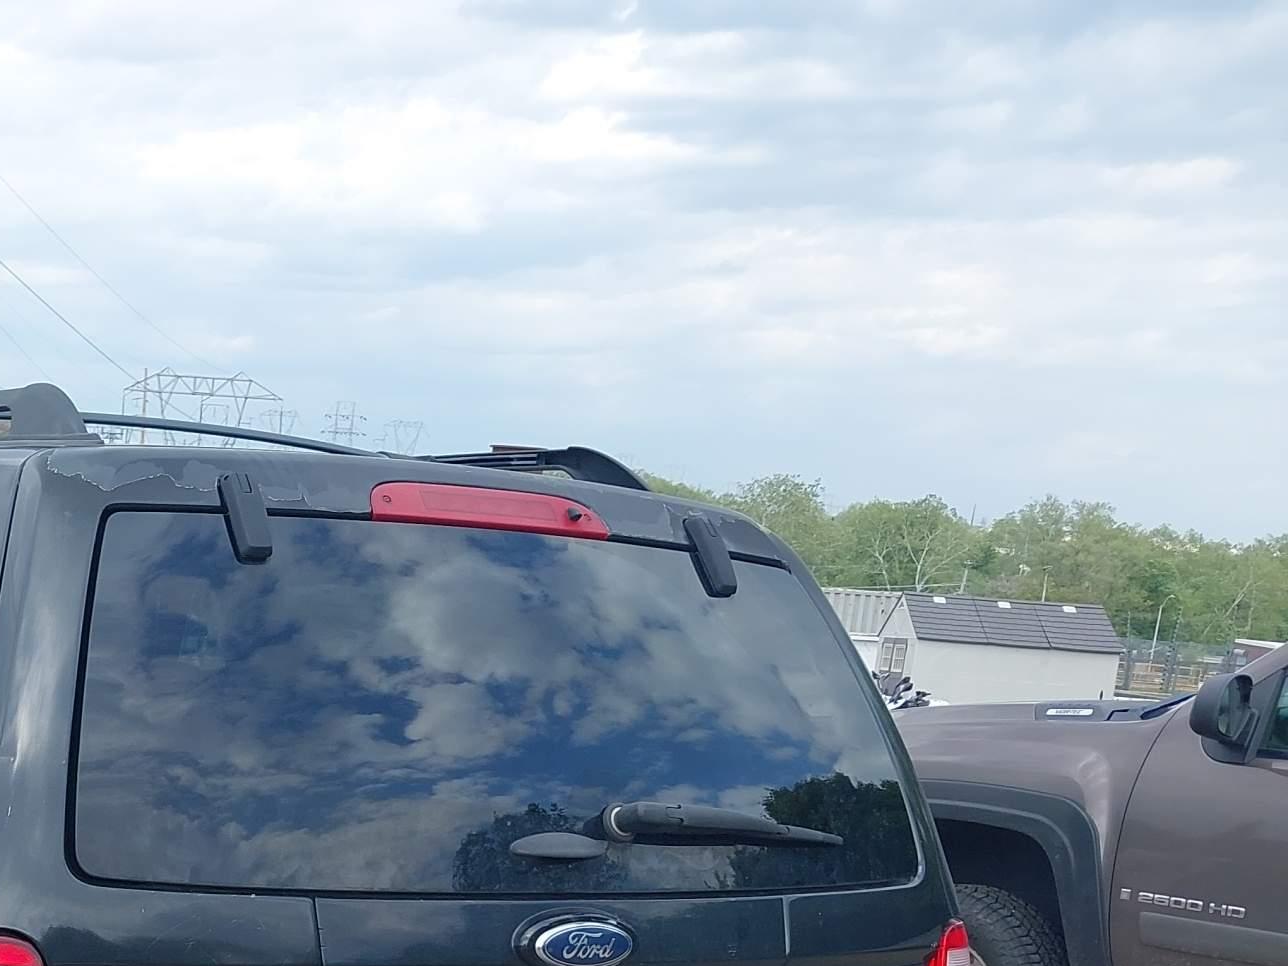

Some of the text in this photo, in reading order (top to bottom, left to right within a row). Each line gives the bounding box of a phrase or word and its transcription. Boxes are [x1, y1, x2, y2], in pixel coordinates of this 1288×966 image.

[1138, 891, 1246, 919] 2500 HD
[562, 931, 616, 959] Ford
